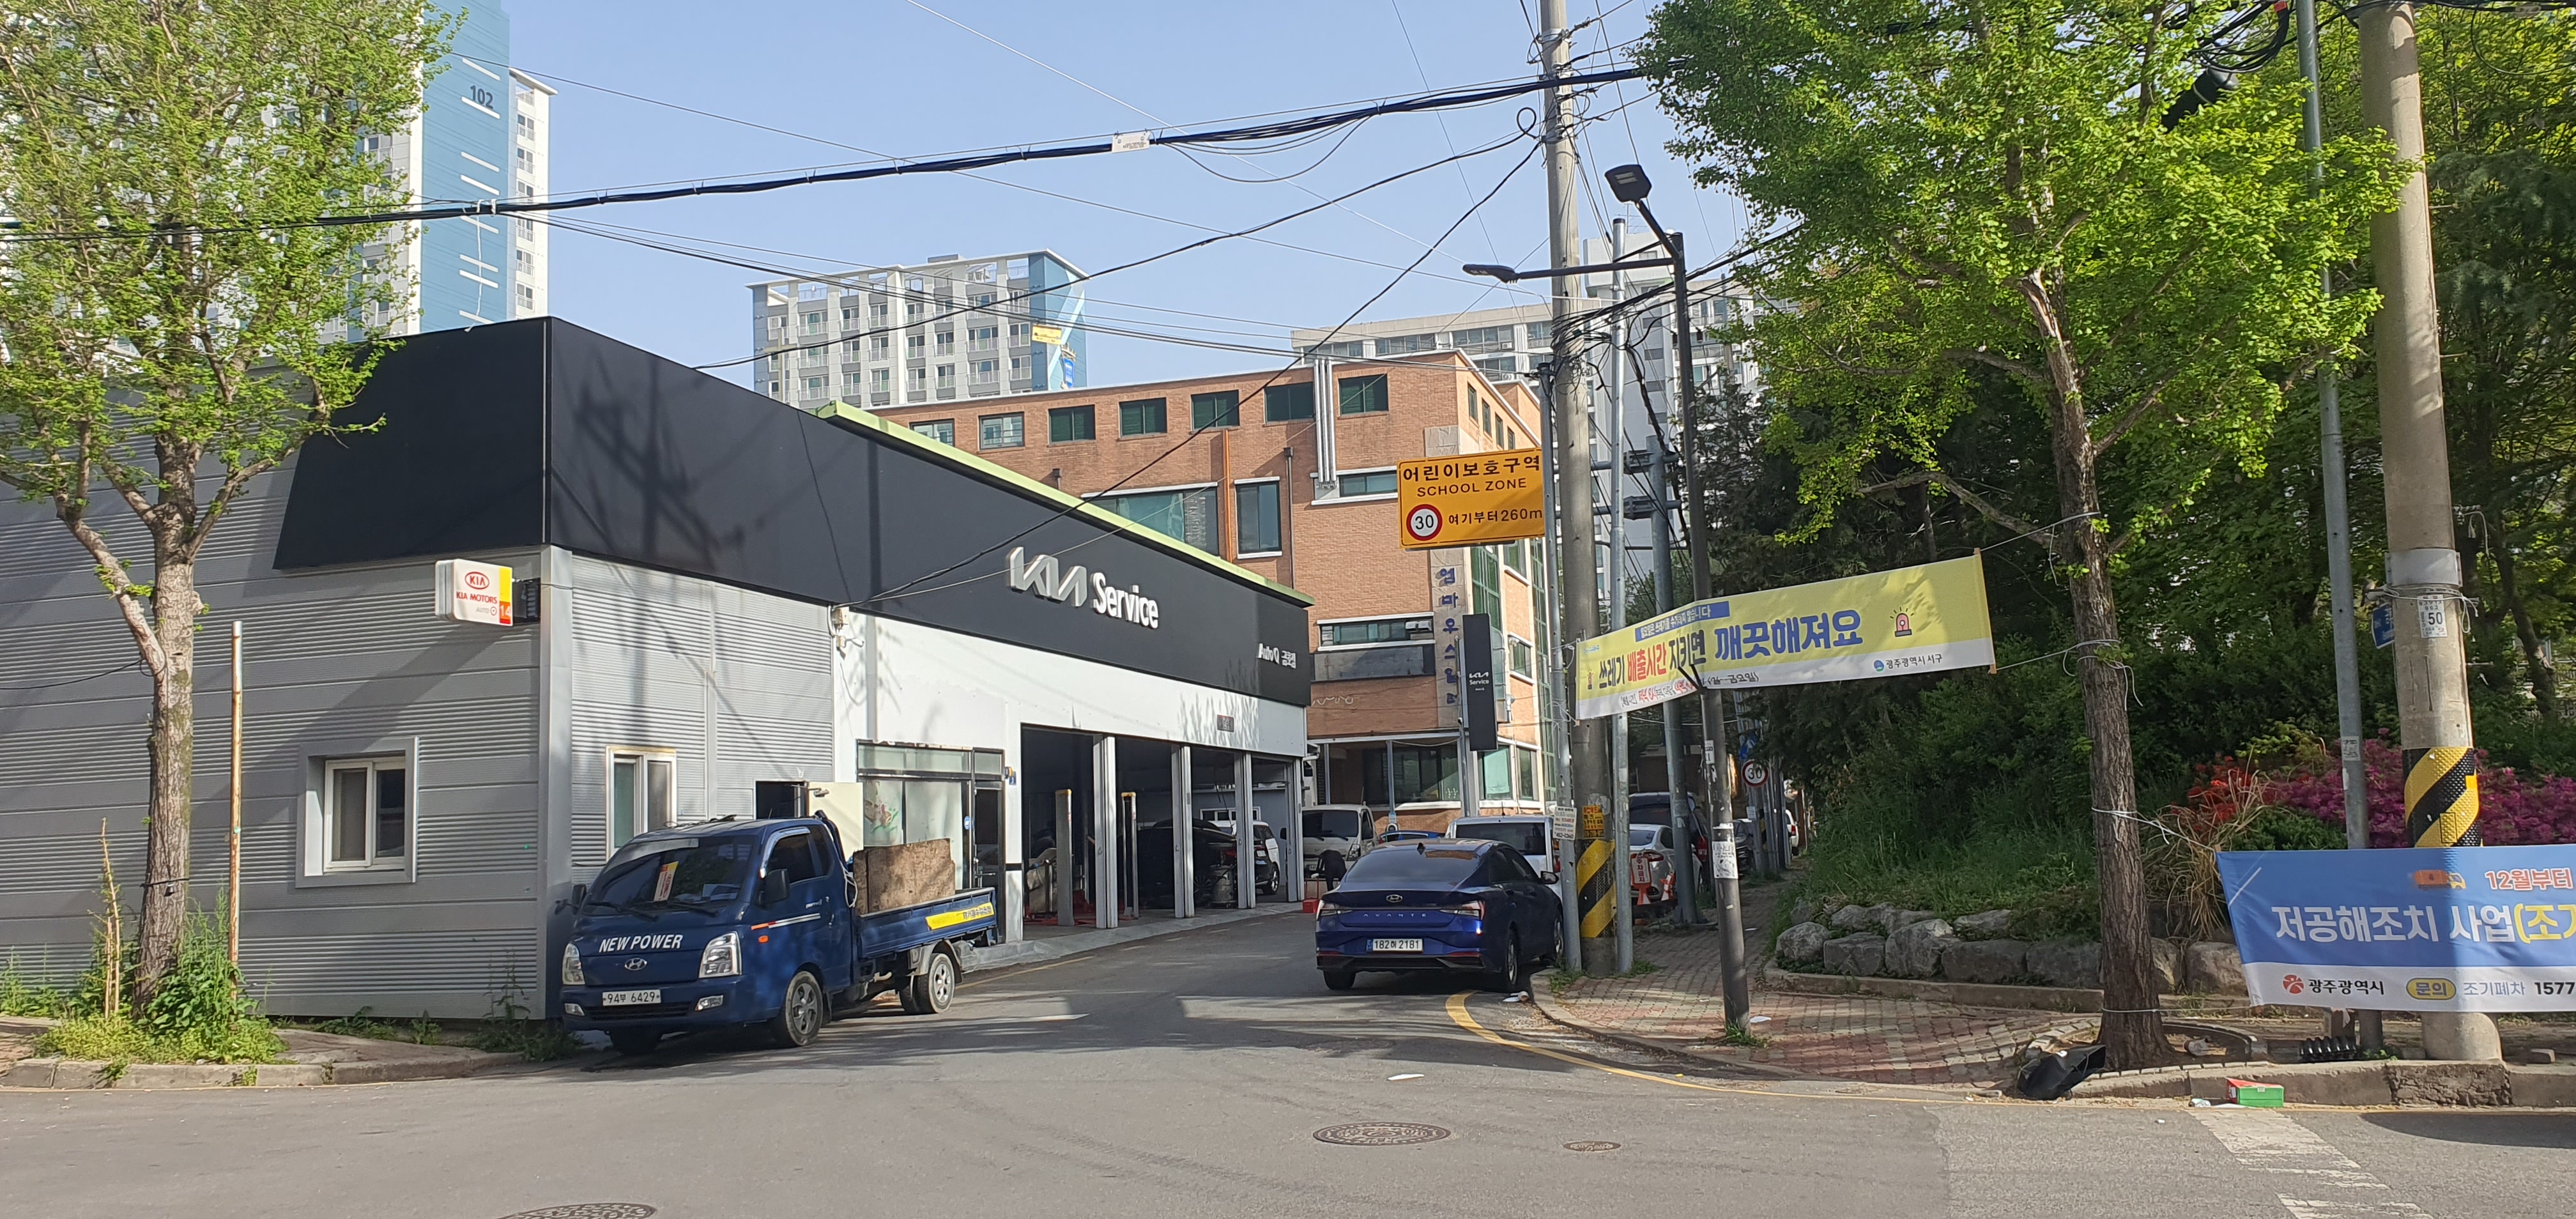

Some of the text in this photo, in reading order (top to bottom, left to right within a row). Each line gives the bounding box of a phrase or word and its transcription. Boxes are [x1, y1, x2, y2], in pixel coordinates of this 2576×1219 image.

[470, 84, 494, 109] 102
[1402, 455, 1540, 482] 어린이보호구역
[1416, 477, 1527, 497] SCHOOL ZONE
[1414, 514, 1434, 530] 30
[470, 575, 486, 586] KIA
[456, 591, 498, 604] KIA MOTORS
[1091, 572, 1159, 630] Service
[2428, 611, 2443, 625] 50
[1598, 608, 1864, 689] 쓰레기 배출시간 지키면 깨끗해져요
[1885, 654, 1943, 670] 광주광역시 서구
[1747, 767, 1763, 779] 30
[2484, 867, 2574, 891] 12월부터
[2270, 905, 2439, 943] 저공해조치
[599, 934, 684, 953] NEW POWER
[1399, 940, 1419, 949] 2181
[2308, 977, 2385, 997] 광주광역시
[2415, 981, 2448, 998] 문의
[2463, 981, 2526, 996] 조기폐차
[631, 991, 656, 1002] 6429
